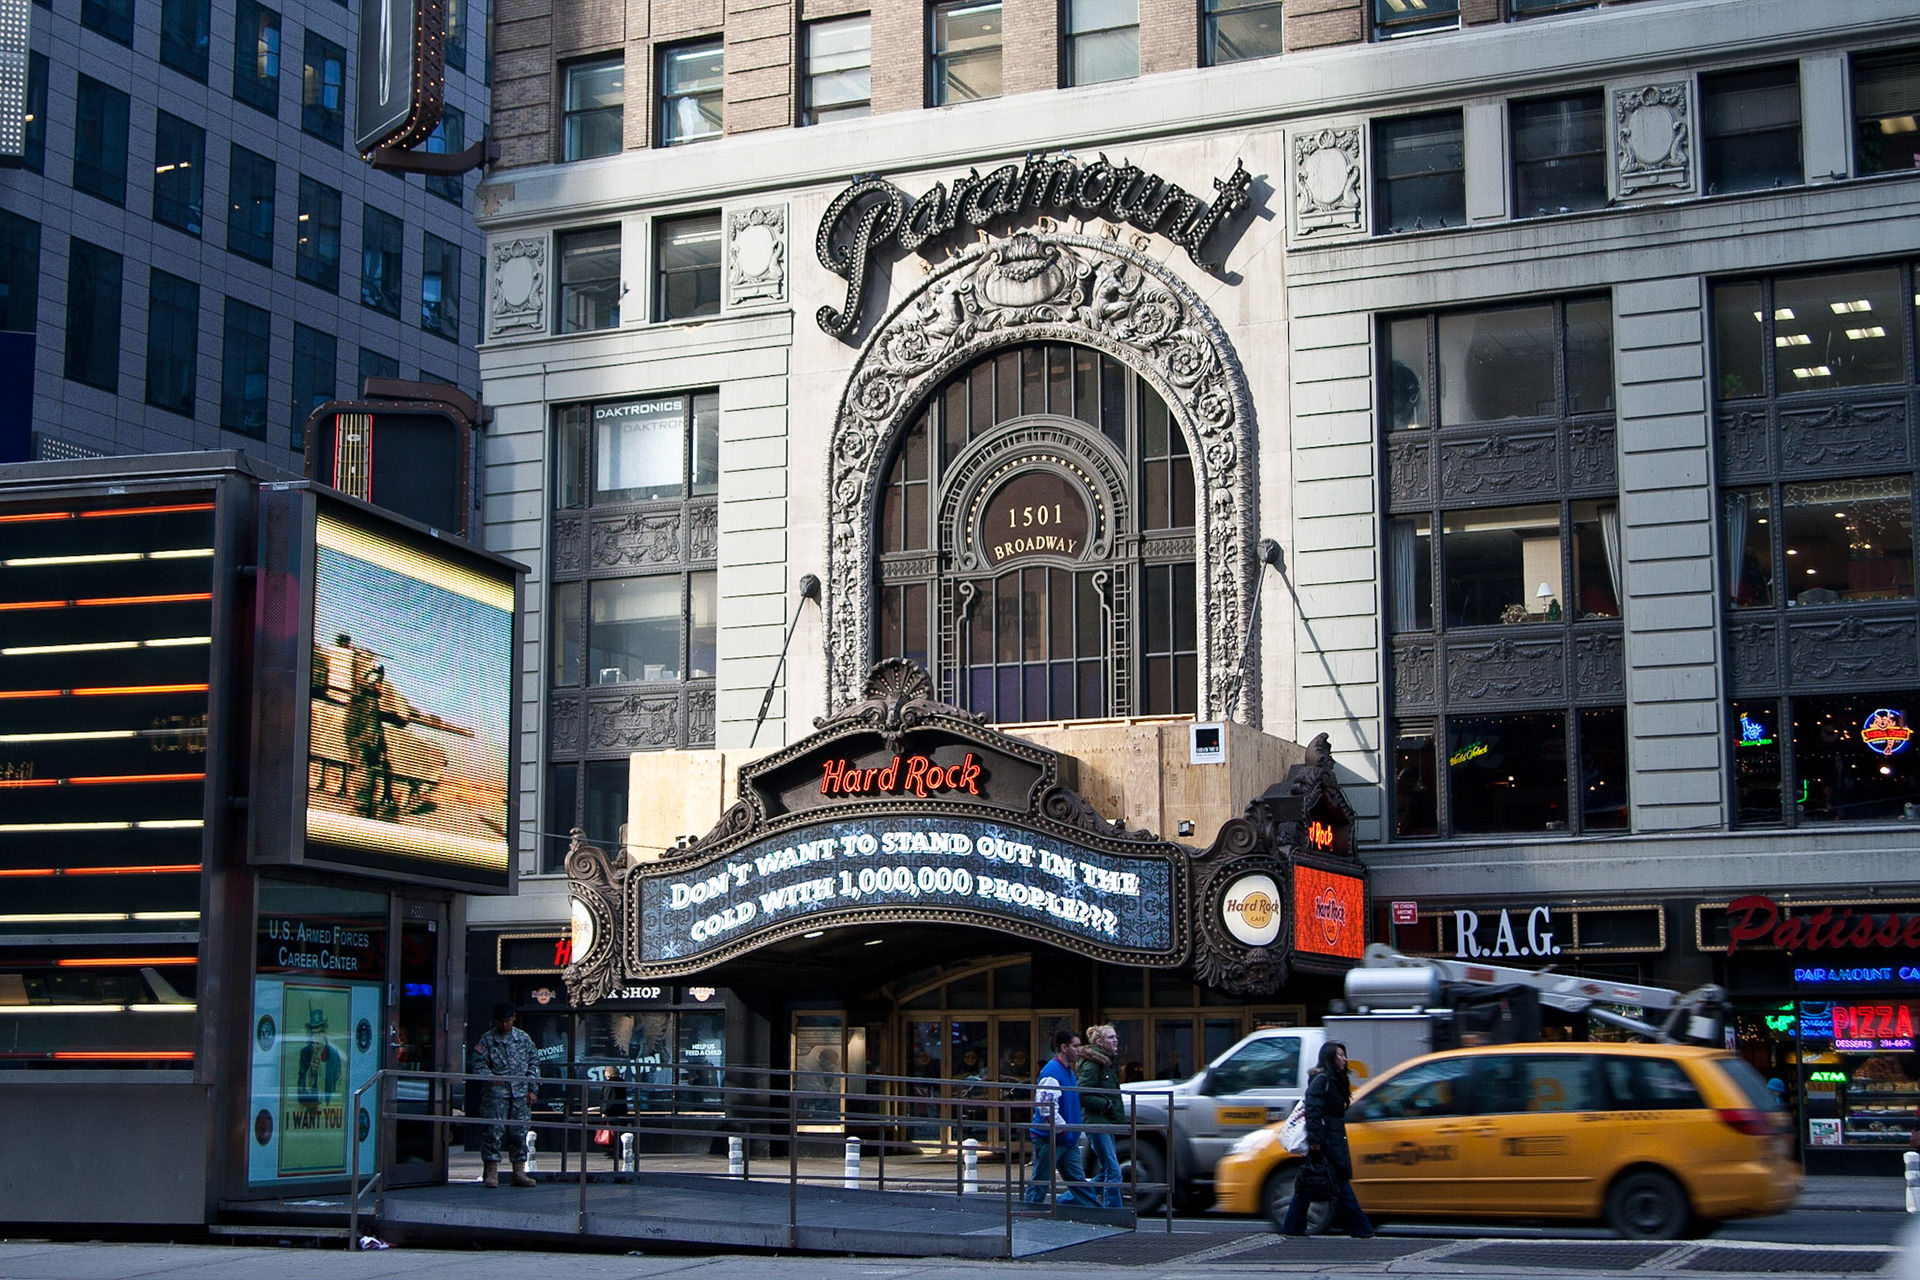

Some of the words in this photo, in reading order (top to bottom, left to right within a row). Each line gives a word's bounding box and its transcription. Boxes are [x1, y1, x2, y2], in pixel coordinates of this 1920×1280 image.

[816, 160, 1250, 337] Paramount
[596, 401, 682, 419] DAKTRONICS
[1009, 504, 1061, 528] 1501
[994, 536, 1077, 560] BROADWAY
[820, 756, 900, 793] Hard
[904, 753, 981, 798] Rock
[670, 862, 752, 909] DON'T
[755, 839, 838, 877] WANT
[840, 834, 877, 858] TO
[882, 832, 973, 855] STAND
[976, 836, 1036, 867] OUT
[1039, 849, 1077, 880] IN
[1079, 861, 1140, 896] THE
[690, 902, 757, 941] COLD
[759, 876, 836, 912] WITH
[839, 866, 973, 901] 1,000,000
[976, 875, 1119, 935] PEOPLE???
[1227, 899, 1257, 913] Hard
[1259, 898, 1280, 915] Rock
[1316, 896, 1330, 919] Hard
[1330, 900, 1346, 926] Rock
[270, 920, 294, 941] U.S.
[298, 923, 331, 944] ARMED
[334, 926, 370, 948] FORCES
[1454, 906, 1561, 958] R.A.G.
[279, 947, 319, 967] CAREER
[321, 950, 358, 971] CENTER
[1794, 967, 1892, 982] PARAMOUNT
[622, 987, 661, 999] SHOP
[1832, 1005, 1914, 1039] PIZZA
[538, 1044, 564, 1057] RYONE
[1835, 1040, 1873, 1049] DESSERTS
[587, 1065, 626, 1081] STP
[1811, 1072, 1846, 1081] ATM
[286, 1111, 290, 1130] I
[292, 1111, 321, 1130] WANT
[323, 1107, 343, 1129] YOU
